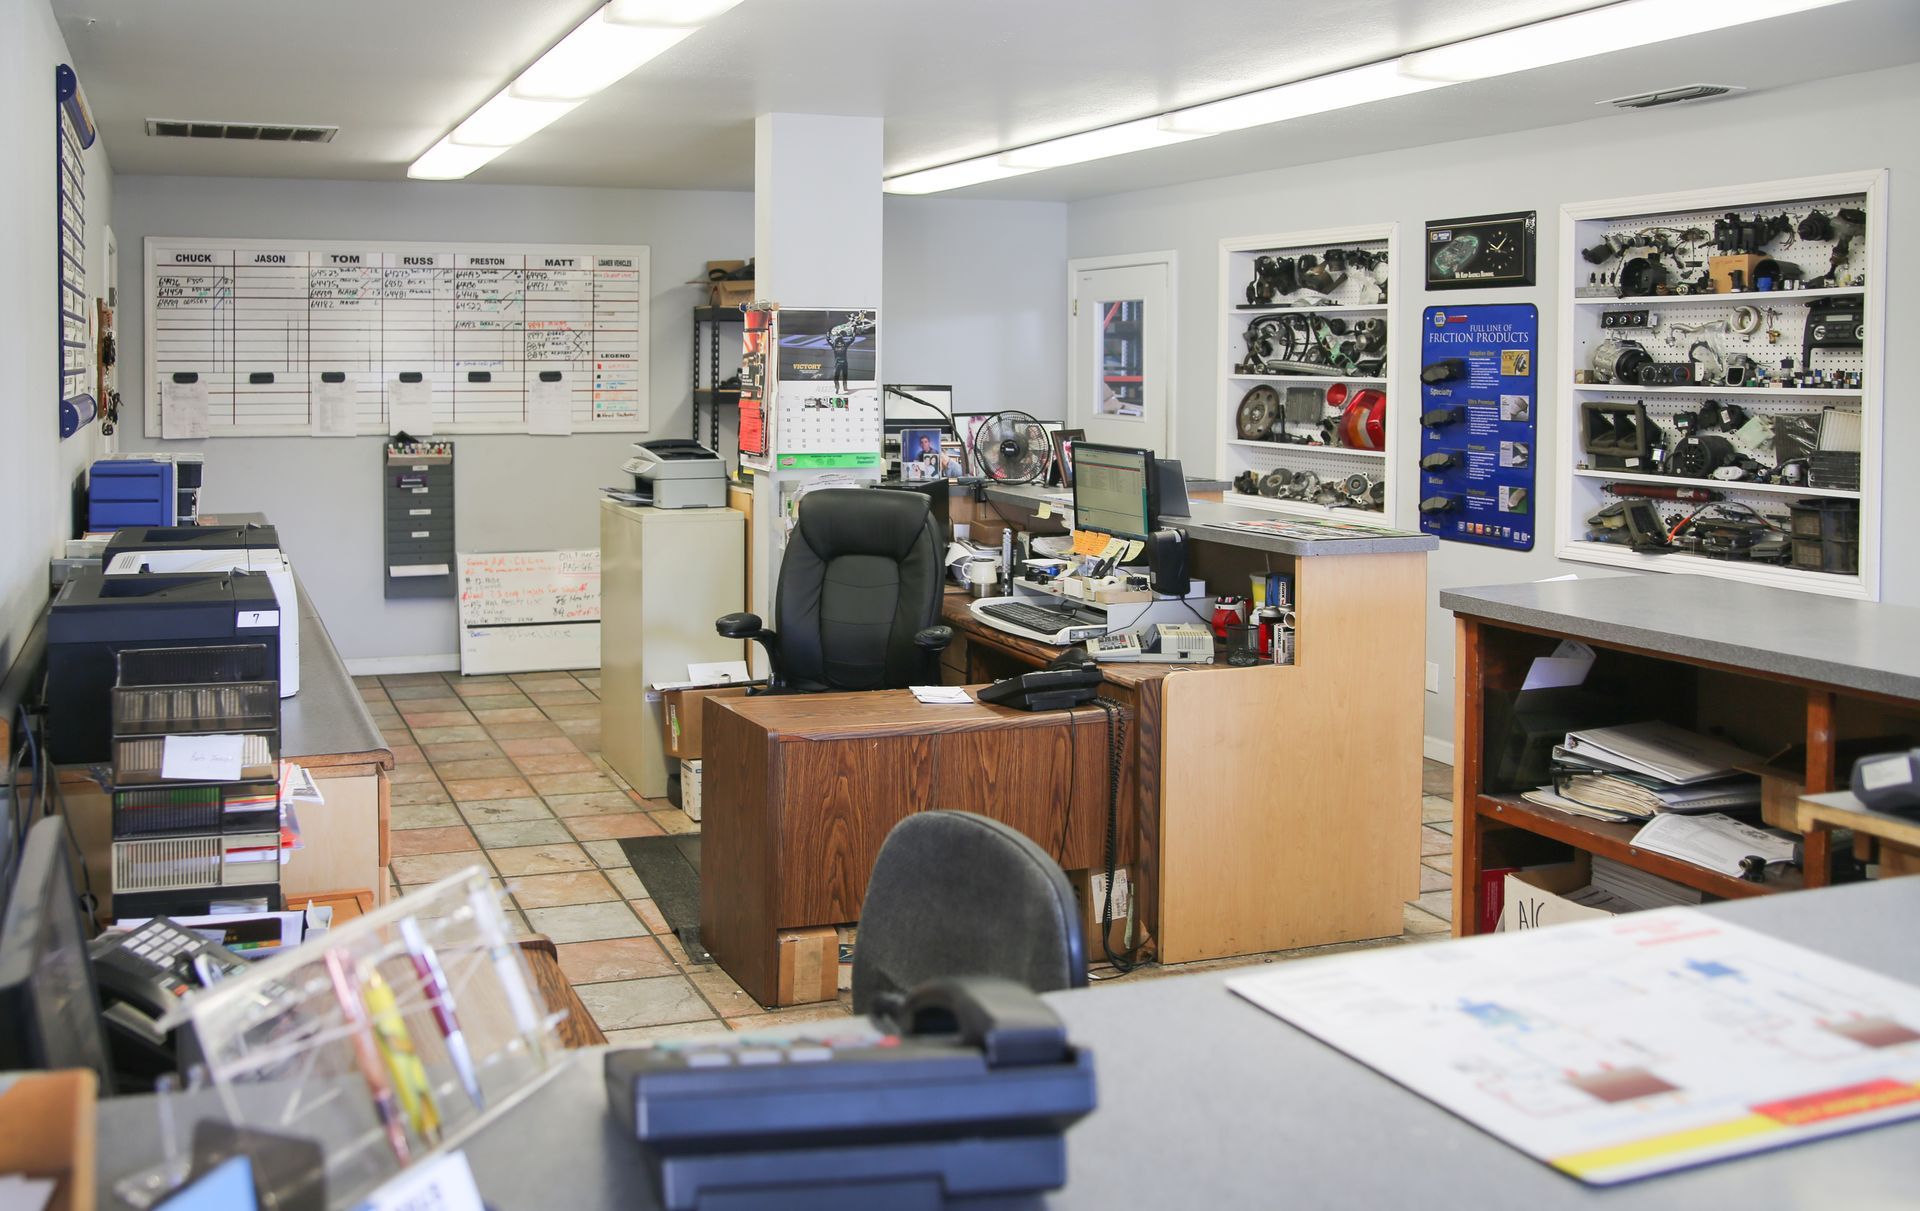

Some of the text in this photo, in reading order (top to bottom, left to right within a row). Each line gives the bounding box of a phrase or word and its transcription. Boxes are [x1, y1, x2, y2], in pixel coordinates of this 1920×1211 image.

[175, 254, 212, 263] CHUCK
[254, 254, 286, 263] JASON
[330, 255, 360, 263] TOM
[403, 257, 434, 265] RUSS
[1486, 324, 1501, 332] LINE
[1503, 324, 1512, 332] OF
[1429, 331, 1529, 343] FRICTION PRODUCTS
[1429, 387, 1453, 397] Specialty
[252, 613, 260, 624] 7
